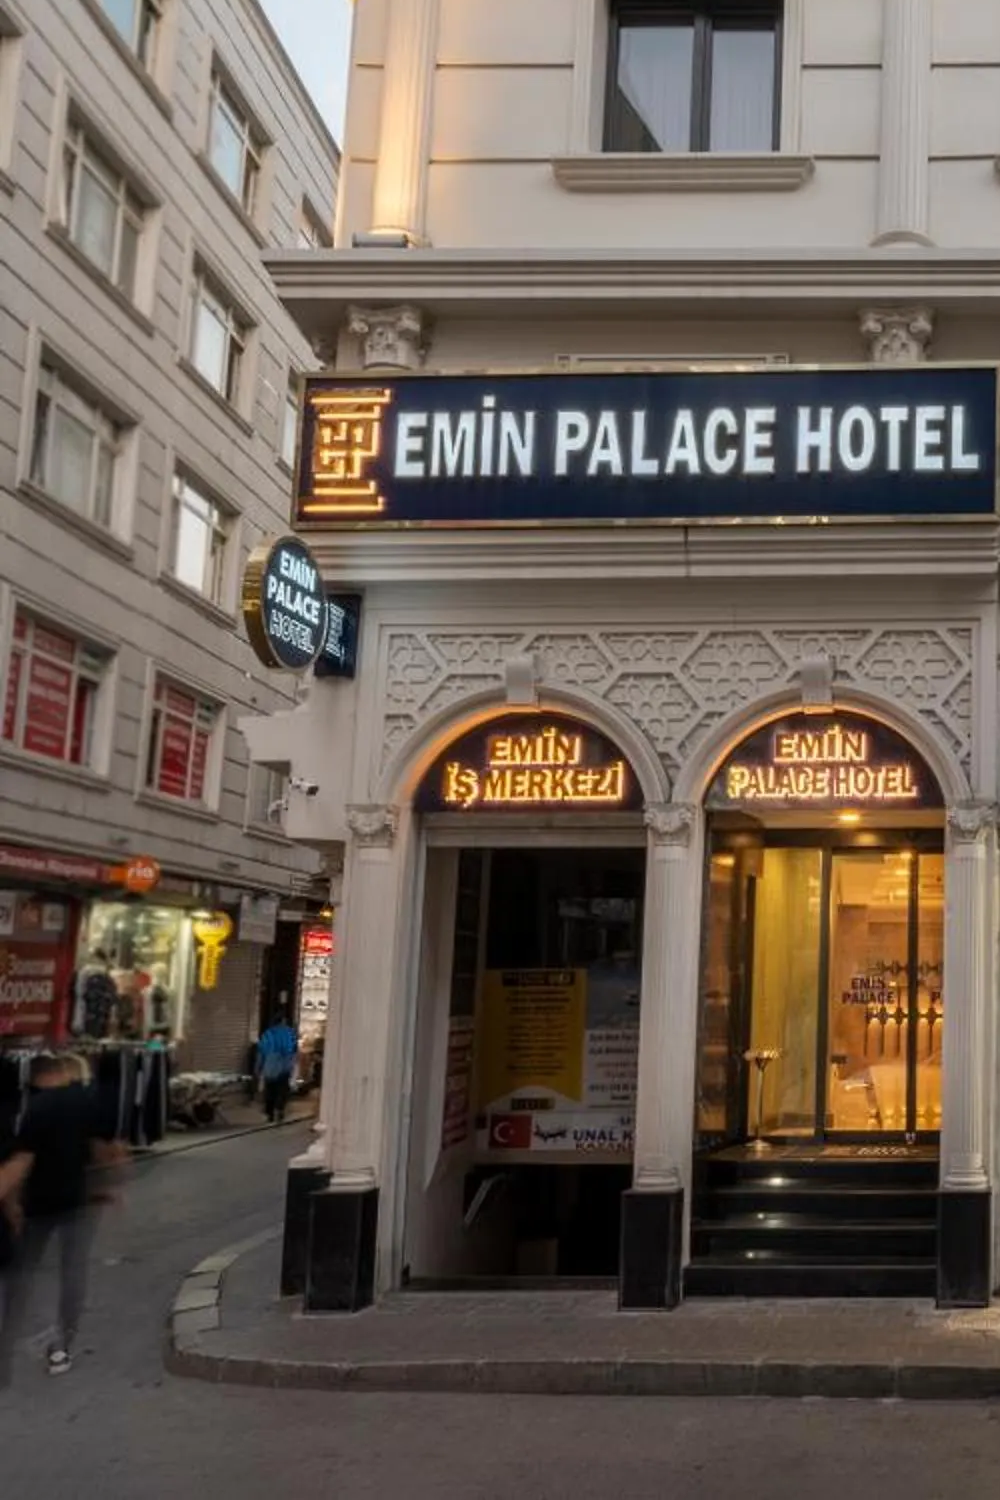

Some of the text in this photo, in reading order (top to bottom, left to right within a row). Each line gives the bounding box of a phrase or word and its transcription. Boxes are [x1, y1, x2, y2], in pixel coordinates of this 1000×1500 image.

[394, 394, 980, 478] EMİN PALACE HOTEL
[280, 549, 317, 592] EMİN
[267, 574, 321, 625] PALACE
[269, 609, 315, 654] HOTEL
[488, 727, 582, 765] EMİN
[773, 724, 868, 762] EMİN
[483, 761, 625, 802] MERKEZİ
[728, 763, 918, 799] PALACE HOTEL
